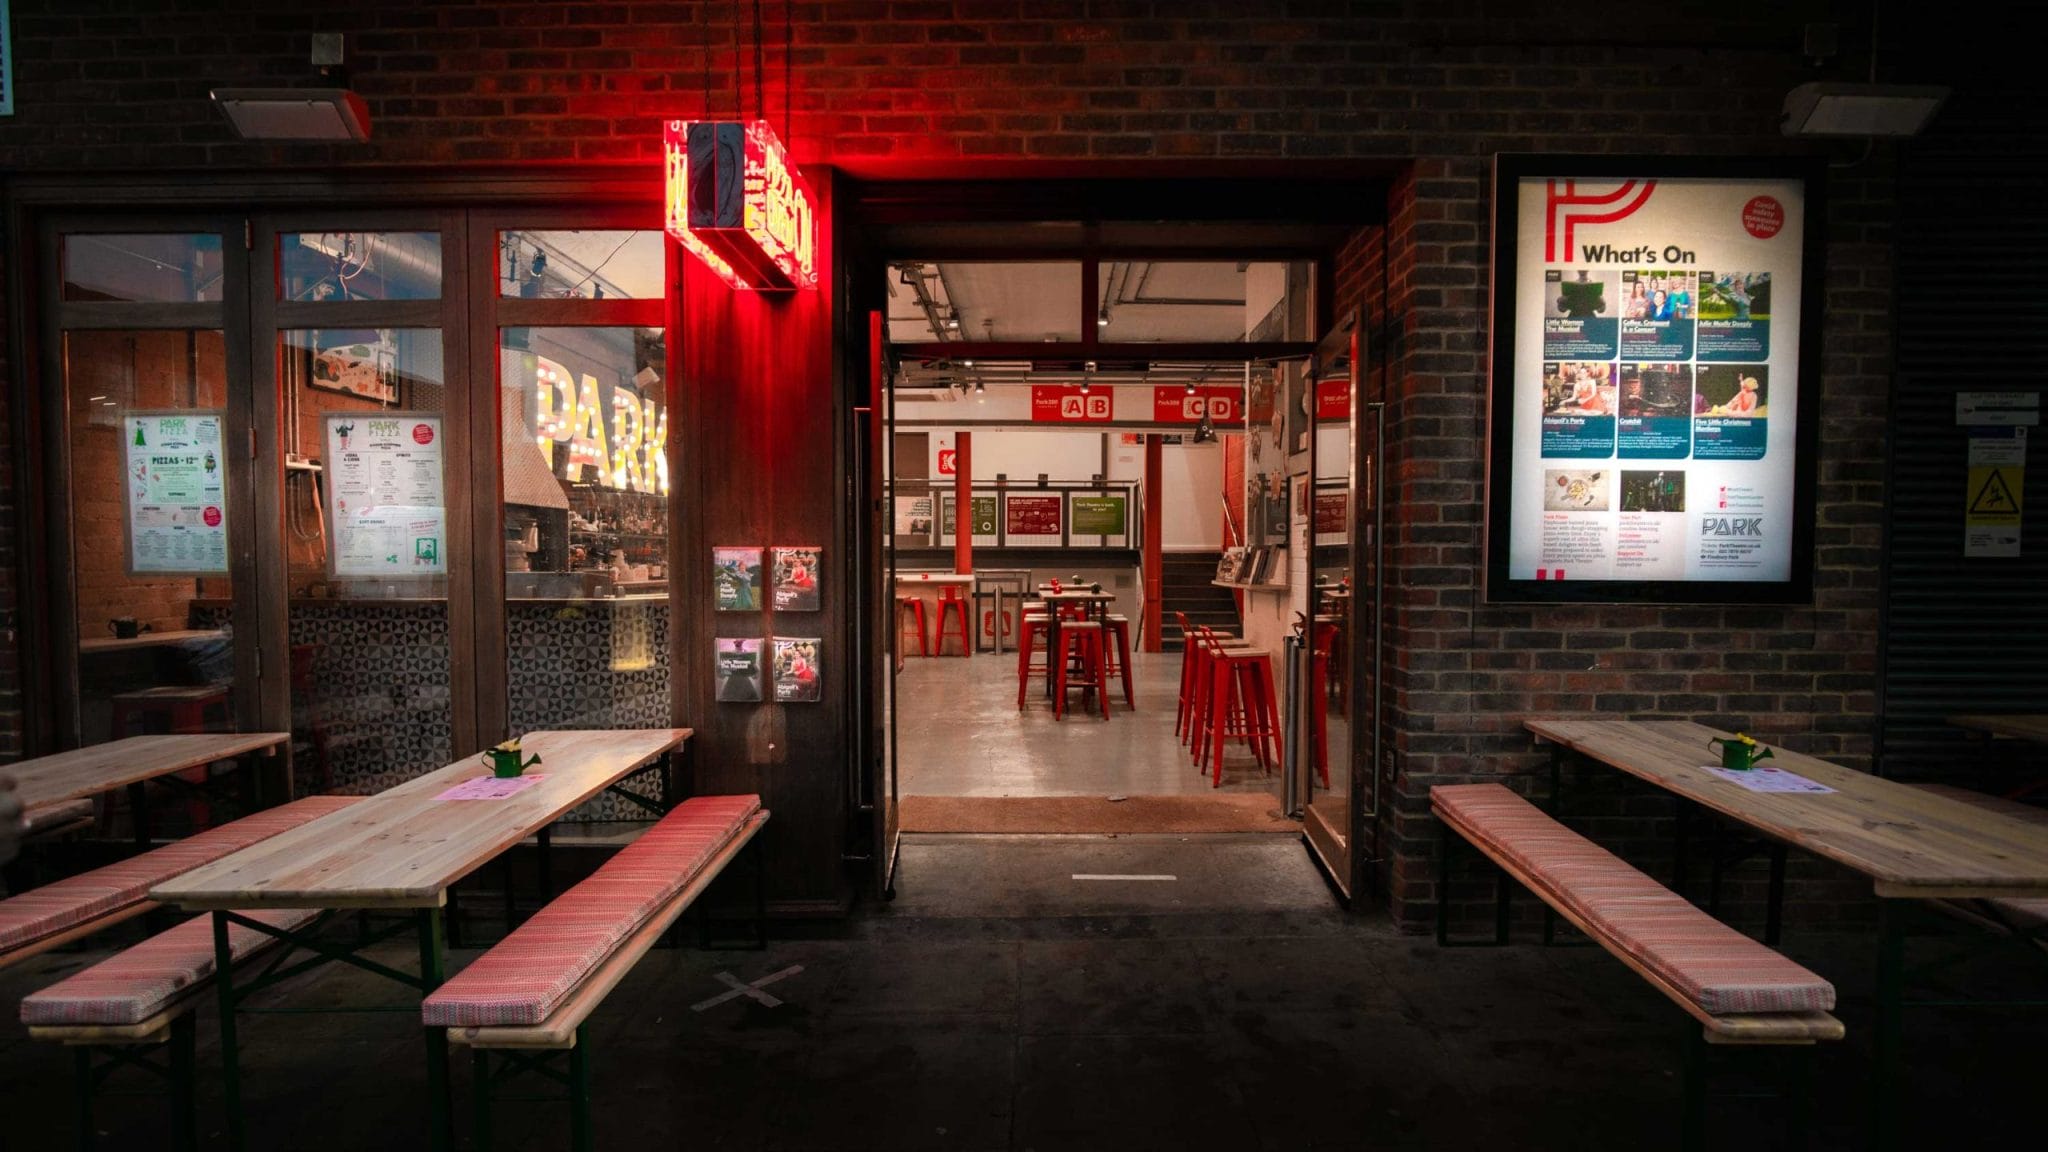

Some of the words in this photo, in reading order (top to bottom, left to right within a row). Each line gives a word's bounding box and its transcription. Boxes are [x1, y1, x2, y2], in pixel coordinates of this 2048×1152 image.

[1663, 246, 1696, 263] On
[1069, 399, 1081, 413] A
[1095, 400, 1106, 413] B
[1191, 400, 1202, 415] C
[1216, 401, 1228, 415] D
[160, 418, 187, 428] PARK
[369, 421, 400, 430] PARK
[537, 355, 668, 497] PARK
[160, 428, 188, 436] PIZZA
[152, 457, 179, 465] PIZZAS
[1702, 518, 1762, 536] PARK
